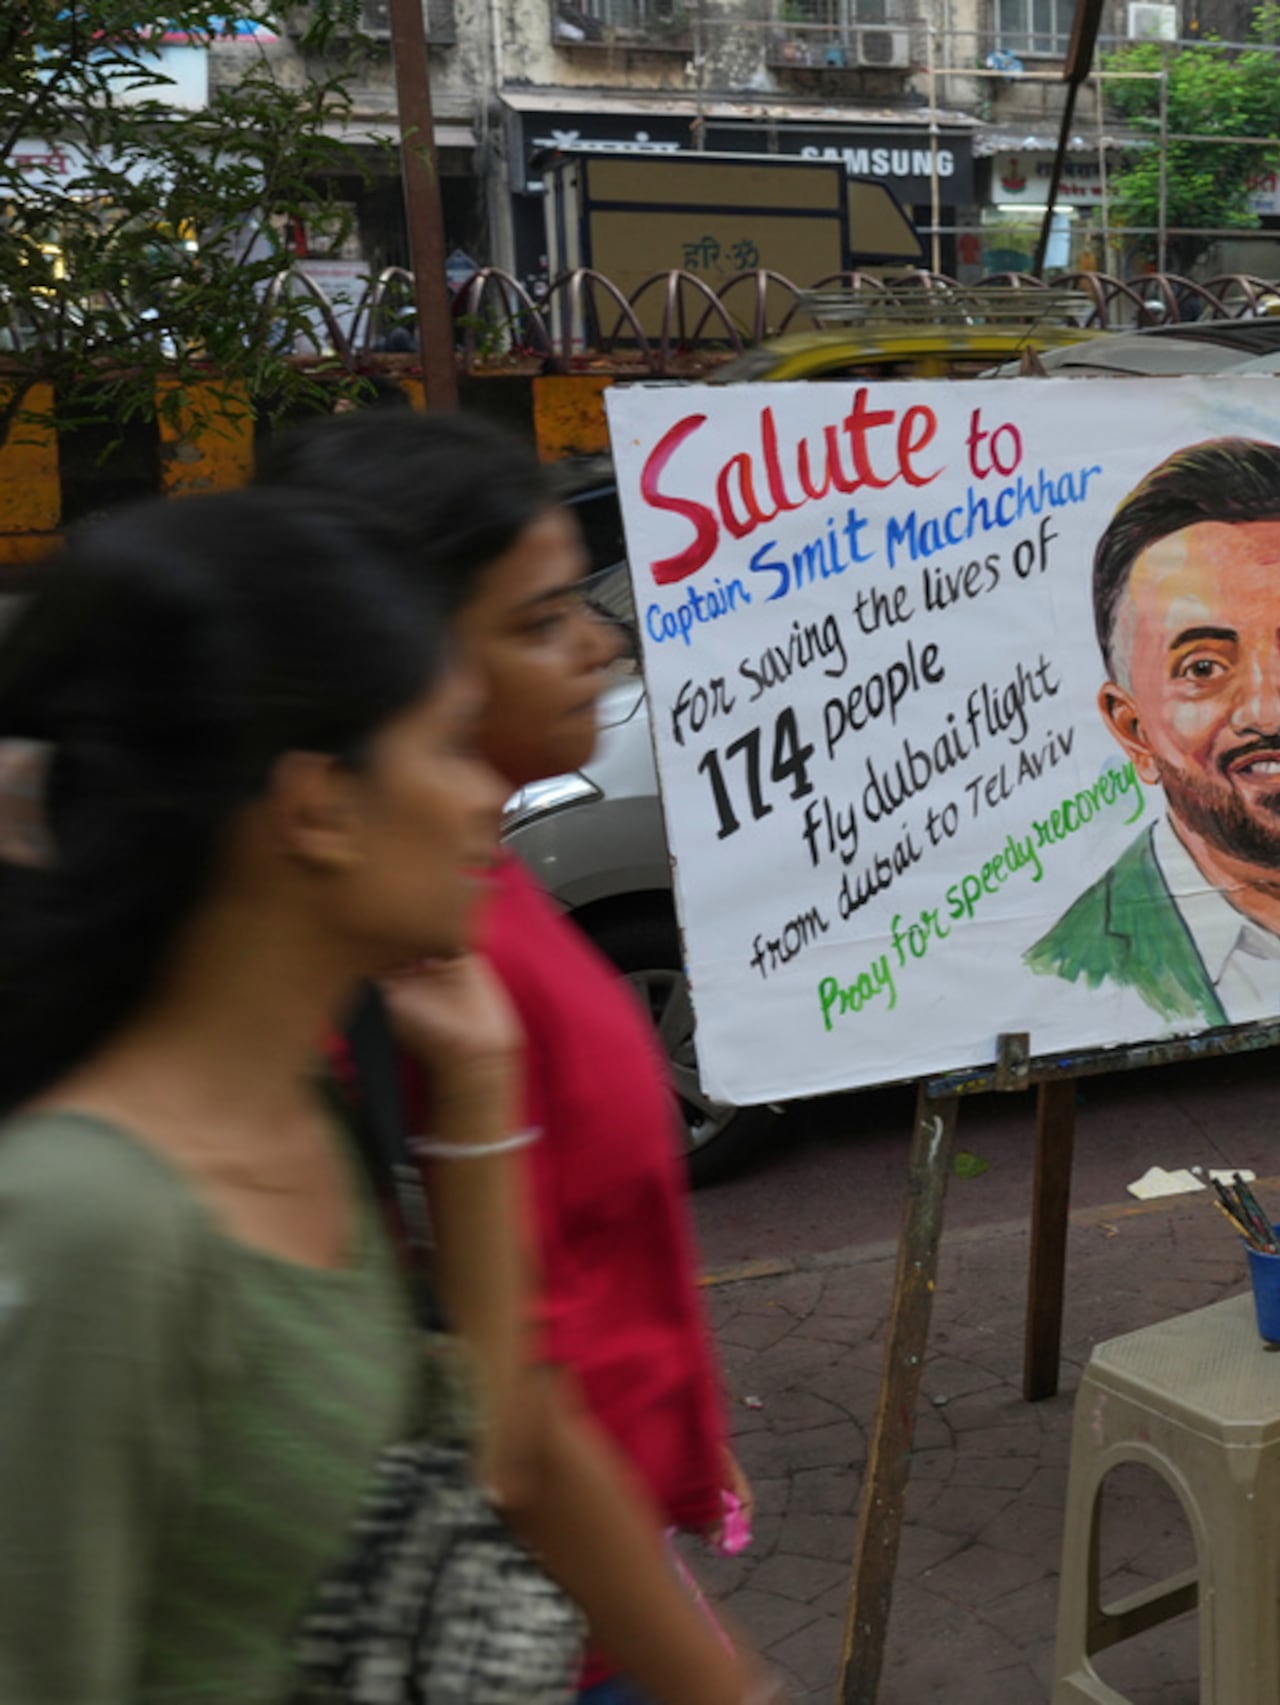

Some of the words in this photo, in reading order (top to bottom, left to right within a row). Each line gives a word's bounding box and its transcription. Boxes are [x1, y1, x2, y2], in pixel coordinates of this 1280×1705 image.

[640, 387, 947, 586] Salute
[966, 407, 1022, 480] to
[646, 577, 752, 647] Captain
[749, 507, 877, 601] Smit
[886, 465, 1103, 570] Machchhar
[738, 613, 848, 703] saving
[853, 584, 916, 634] the
[923, 553, 1001, 613] lives
[1013, 515, 1059, 580] of
[697, 706, 816, 841] 174
[822, 639, 946, 761] people
[749, 906, 830, 979] from
[838, 823, 923, 921] dubai
[924, 797, 959, 847] to
[1018, 726, 1075, 785] Aviv
[817, 954, 897, 1032] Pray
[891, 907, 951, 968] for
[945, 834, 1044, 921] speedy
[1032, 760, 1145, 849] recovery
